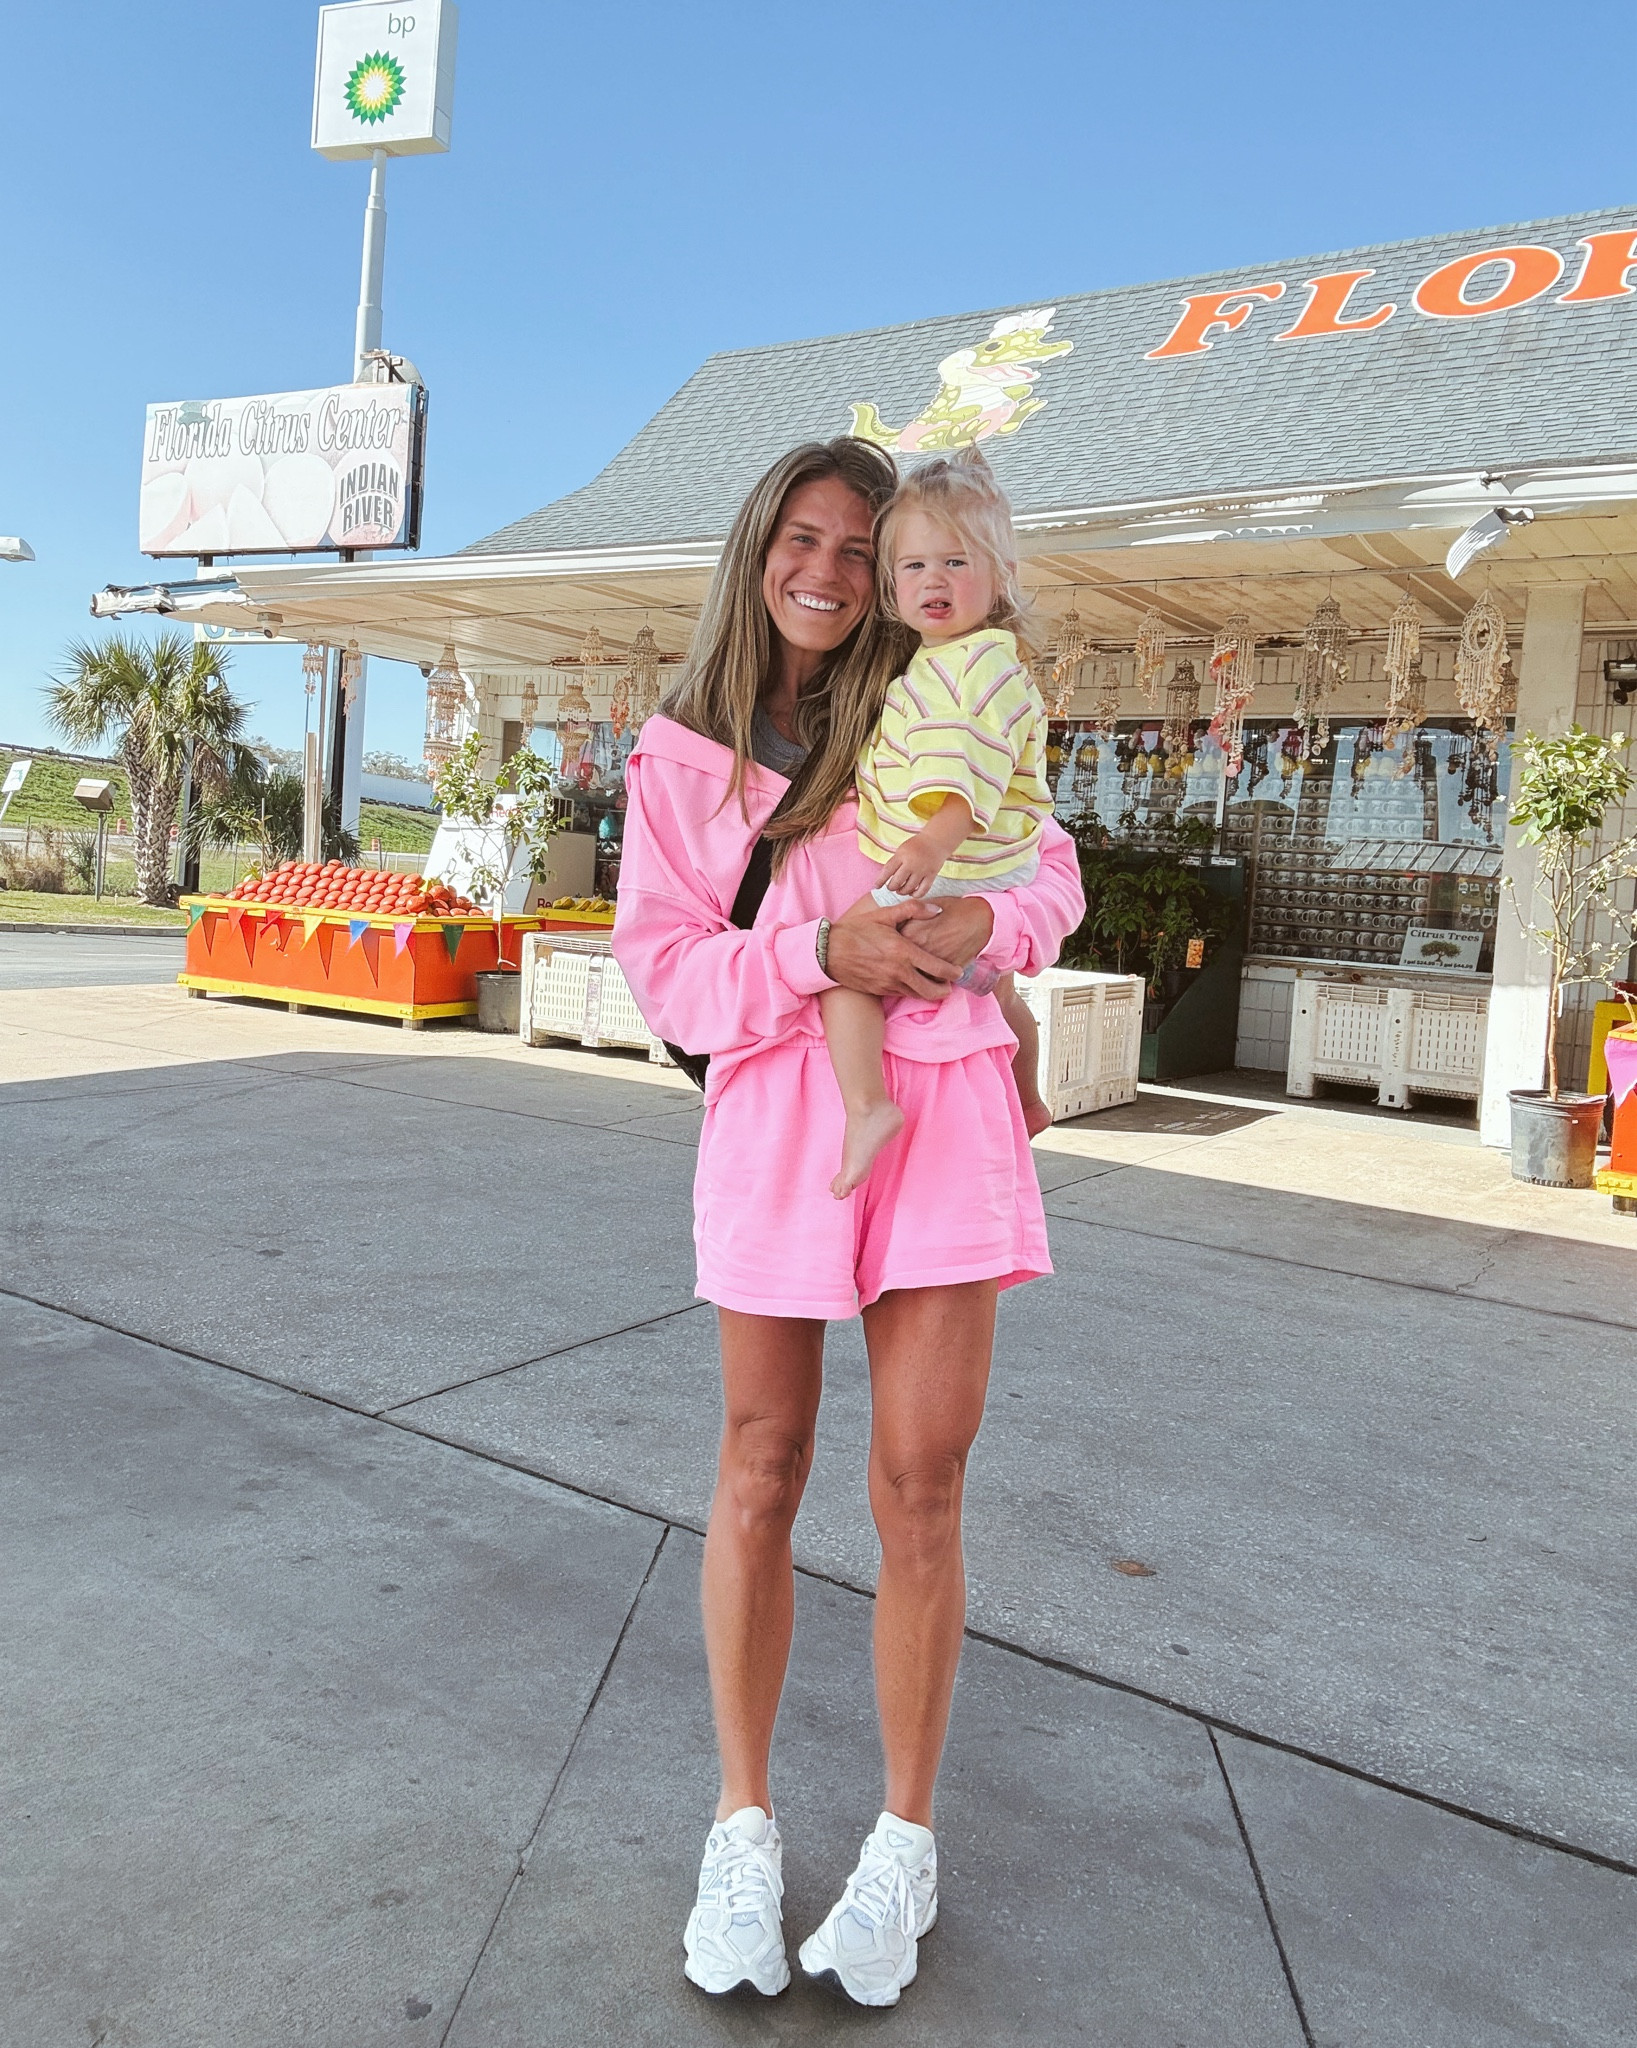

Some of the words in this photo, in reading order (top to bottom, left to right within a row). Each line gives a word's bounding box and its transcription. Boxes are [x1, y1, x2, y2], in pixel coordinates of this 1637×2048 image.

[388, 12, 416, 39] bp
[149, 402, 233, 462] Florida
[238, 398, 312, 456] Citrus
[317, 393, 401, 452] Center
[339, 462, 399, 506] INDIAN
[342, 495, 394, 536] RIVER
[1410, 929, 1445, 940] Citrus
[1448, 932, 1480, 942] Trees
